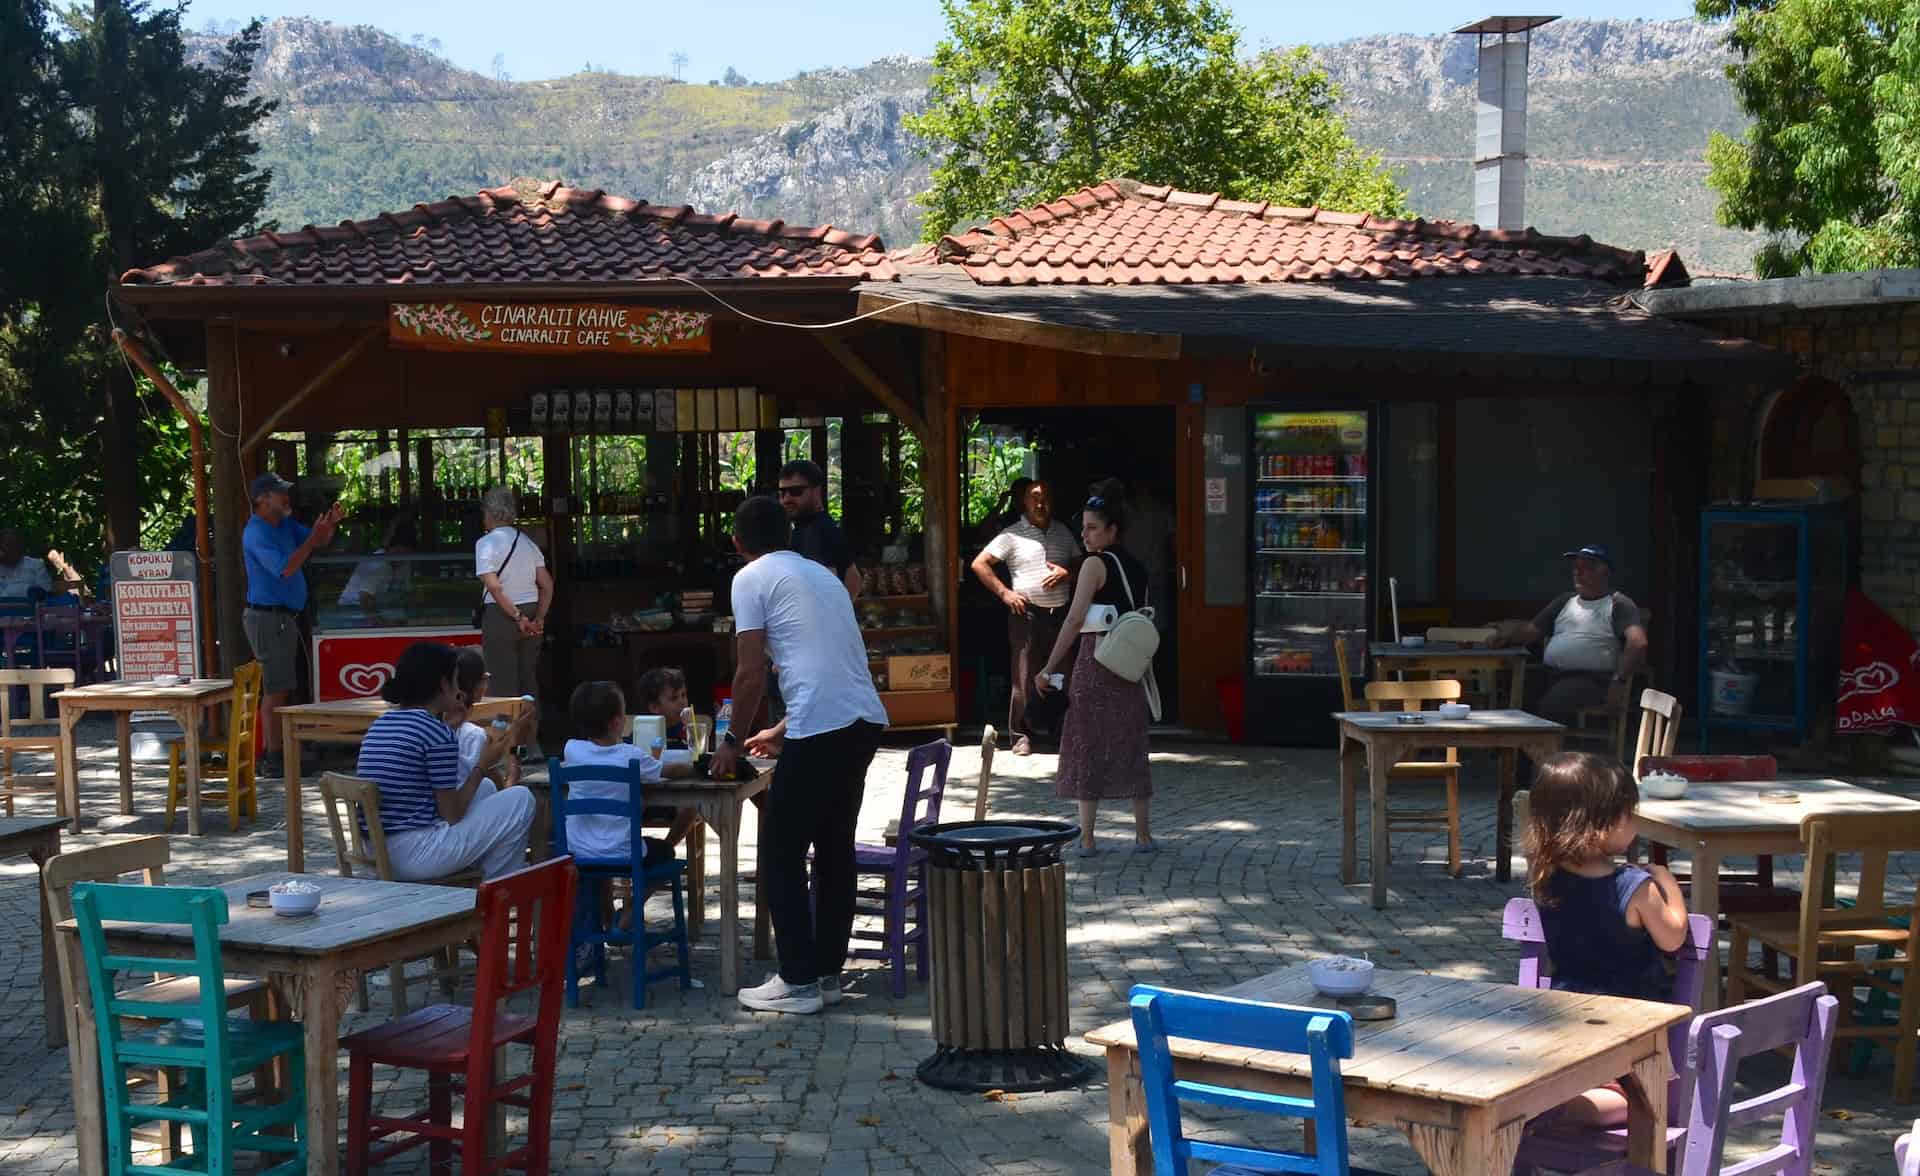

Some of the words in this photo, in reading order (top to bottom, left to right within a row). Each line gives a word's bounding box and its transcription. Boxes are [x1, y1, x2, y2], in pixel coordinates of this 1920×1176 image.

[481, 305, 573, 328] ÇINARALTI
[577, 308, 628, 328] KAHVE
[577, 330, 610, 345] CAFE
[138, 569, 168, 577] AYRAN
[119, 584, 190, 599] KORKUTLAR
[122, 602, 189, 616] CAFETERYA
